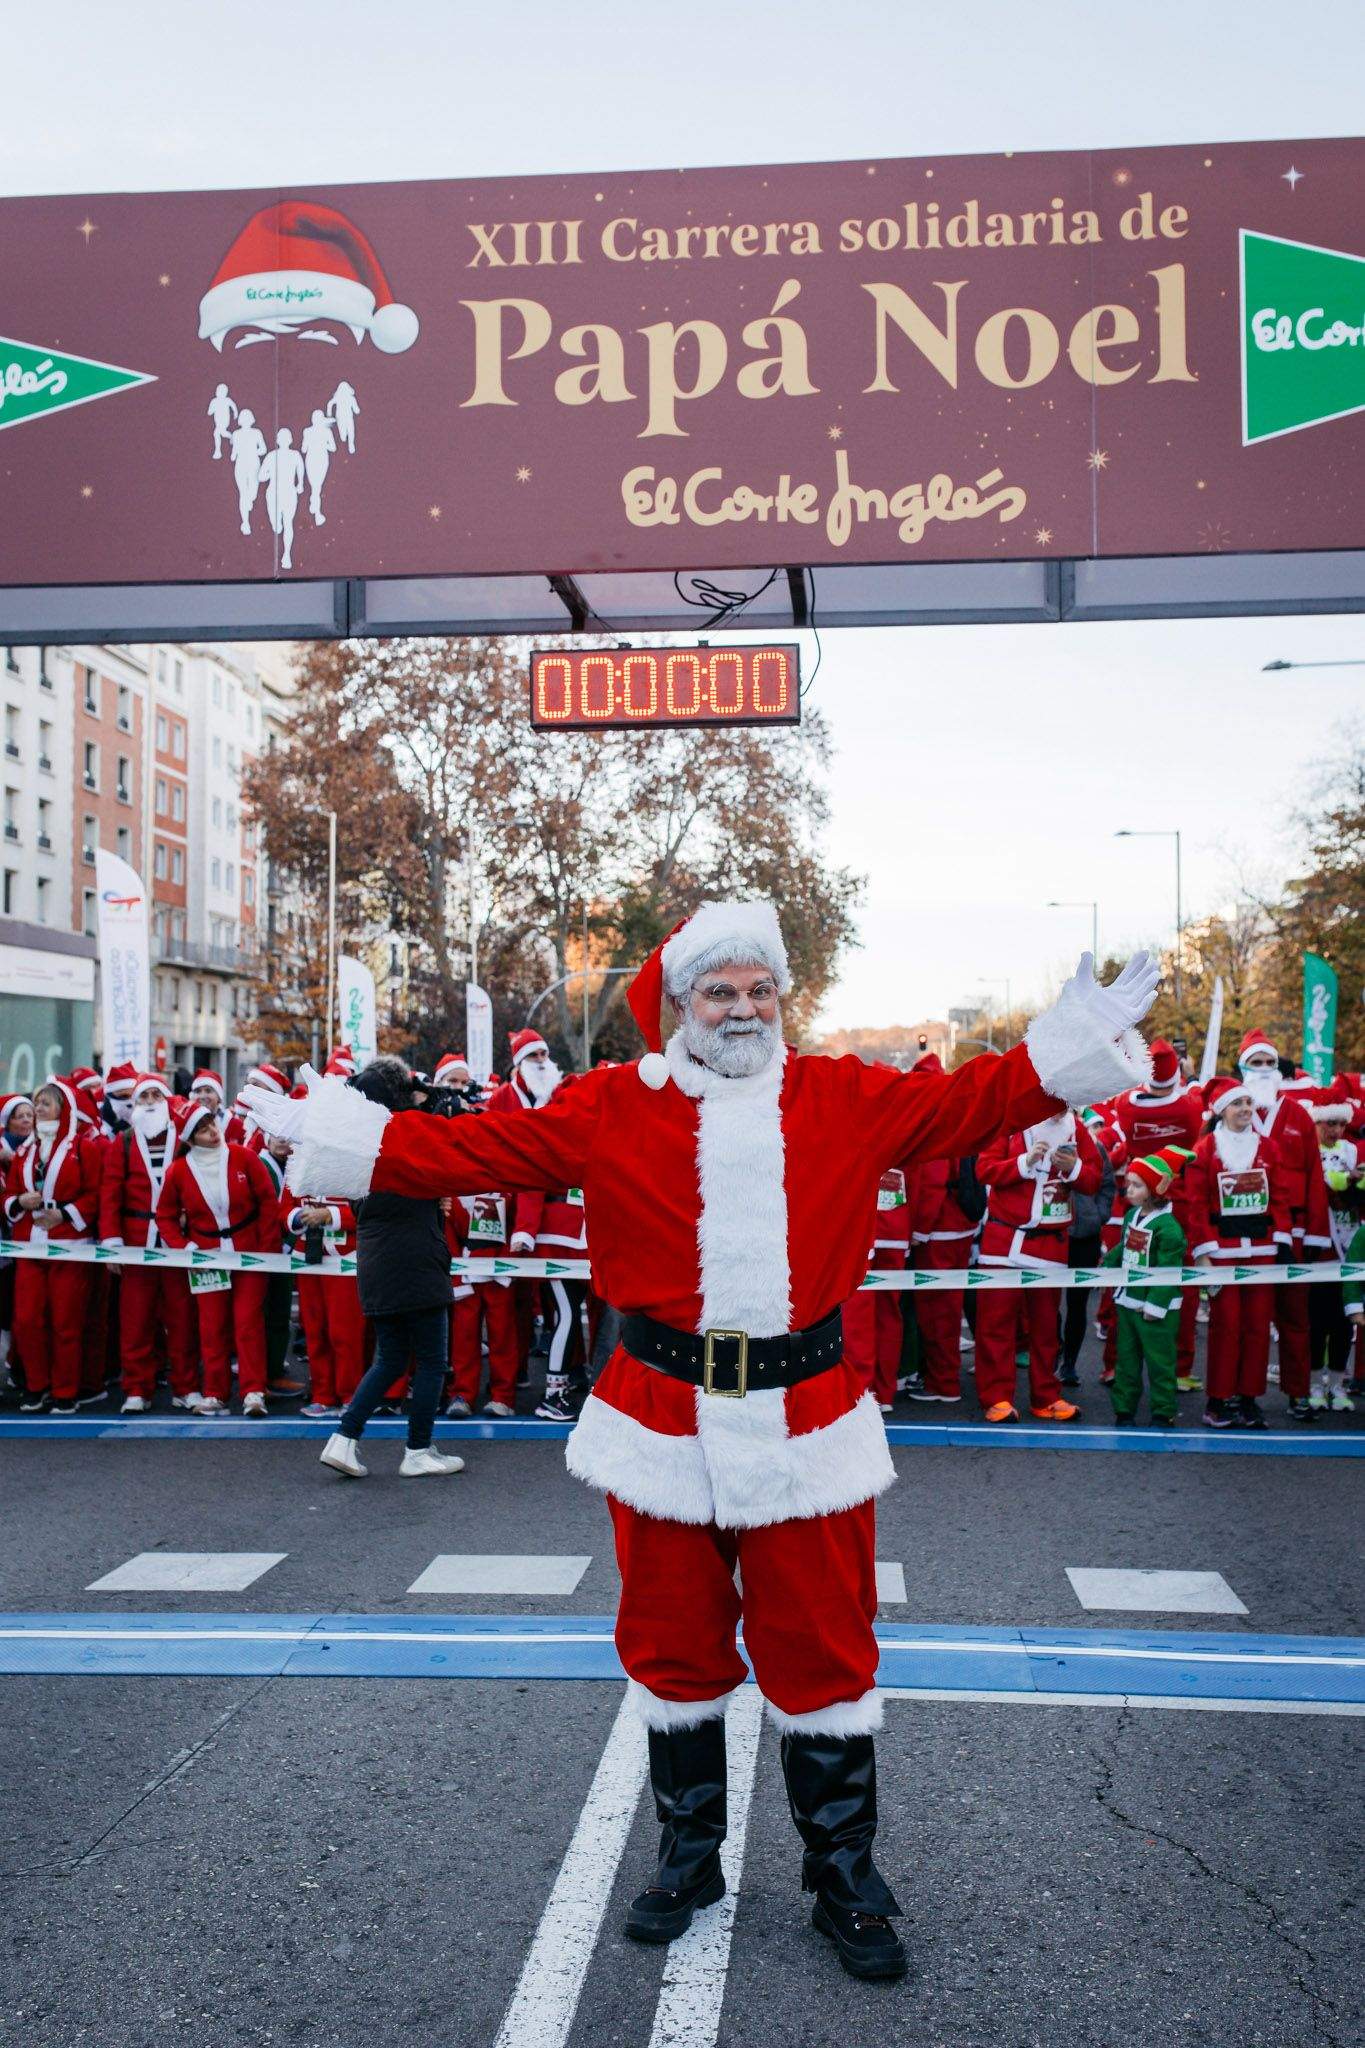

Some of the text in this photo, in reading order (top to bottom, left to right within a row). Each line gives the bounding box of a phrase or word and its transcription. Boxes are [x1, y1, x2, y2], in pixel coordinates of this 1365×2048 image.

[465, 191, 1190, 268] XIII Carrera solidaria de
[458, 263, 1199, 438] Papá Noel
[1251, 307, 1365, 352] El Cor
[621, 449, 1027, 547] El Corte Inglés
[537, 651, 788, 719] 00:00:00
[1231, 1192, 1261, 1208] 7312
[196, 1270, 222, 1287] 3404
